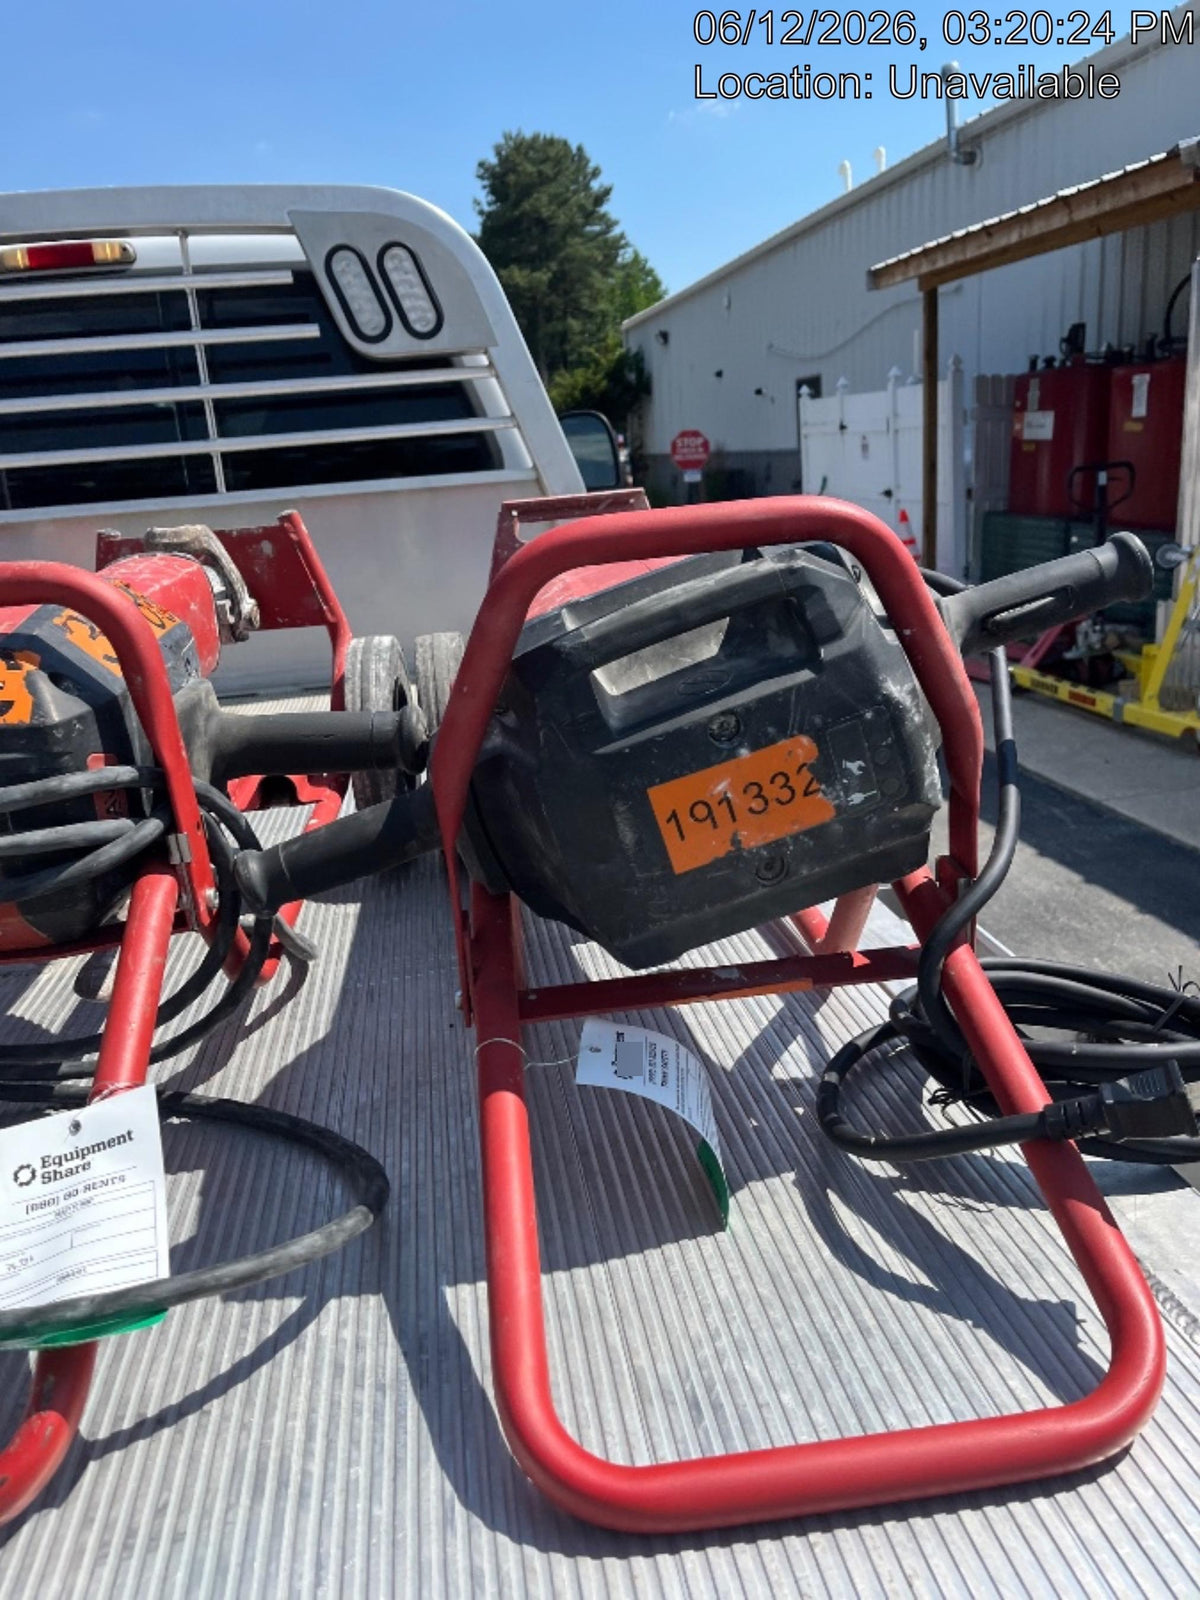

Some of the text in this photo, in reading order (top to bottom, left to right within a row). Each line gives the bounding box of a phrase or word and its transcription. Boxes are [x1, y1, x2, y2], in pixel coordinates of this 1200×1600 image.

[665, 762, 821, 842] 191332
[40, 1129, 135, 1170] Equipment
[41, 1160, 92, 1186] Share
